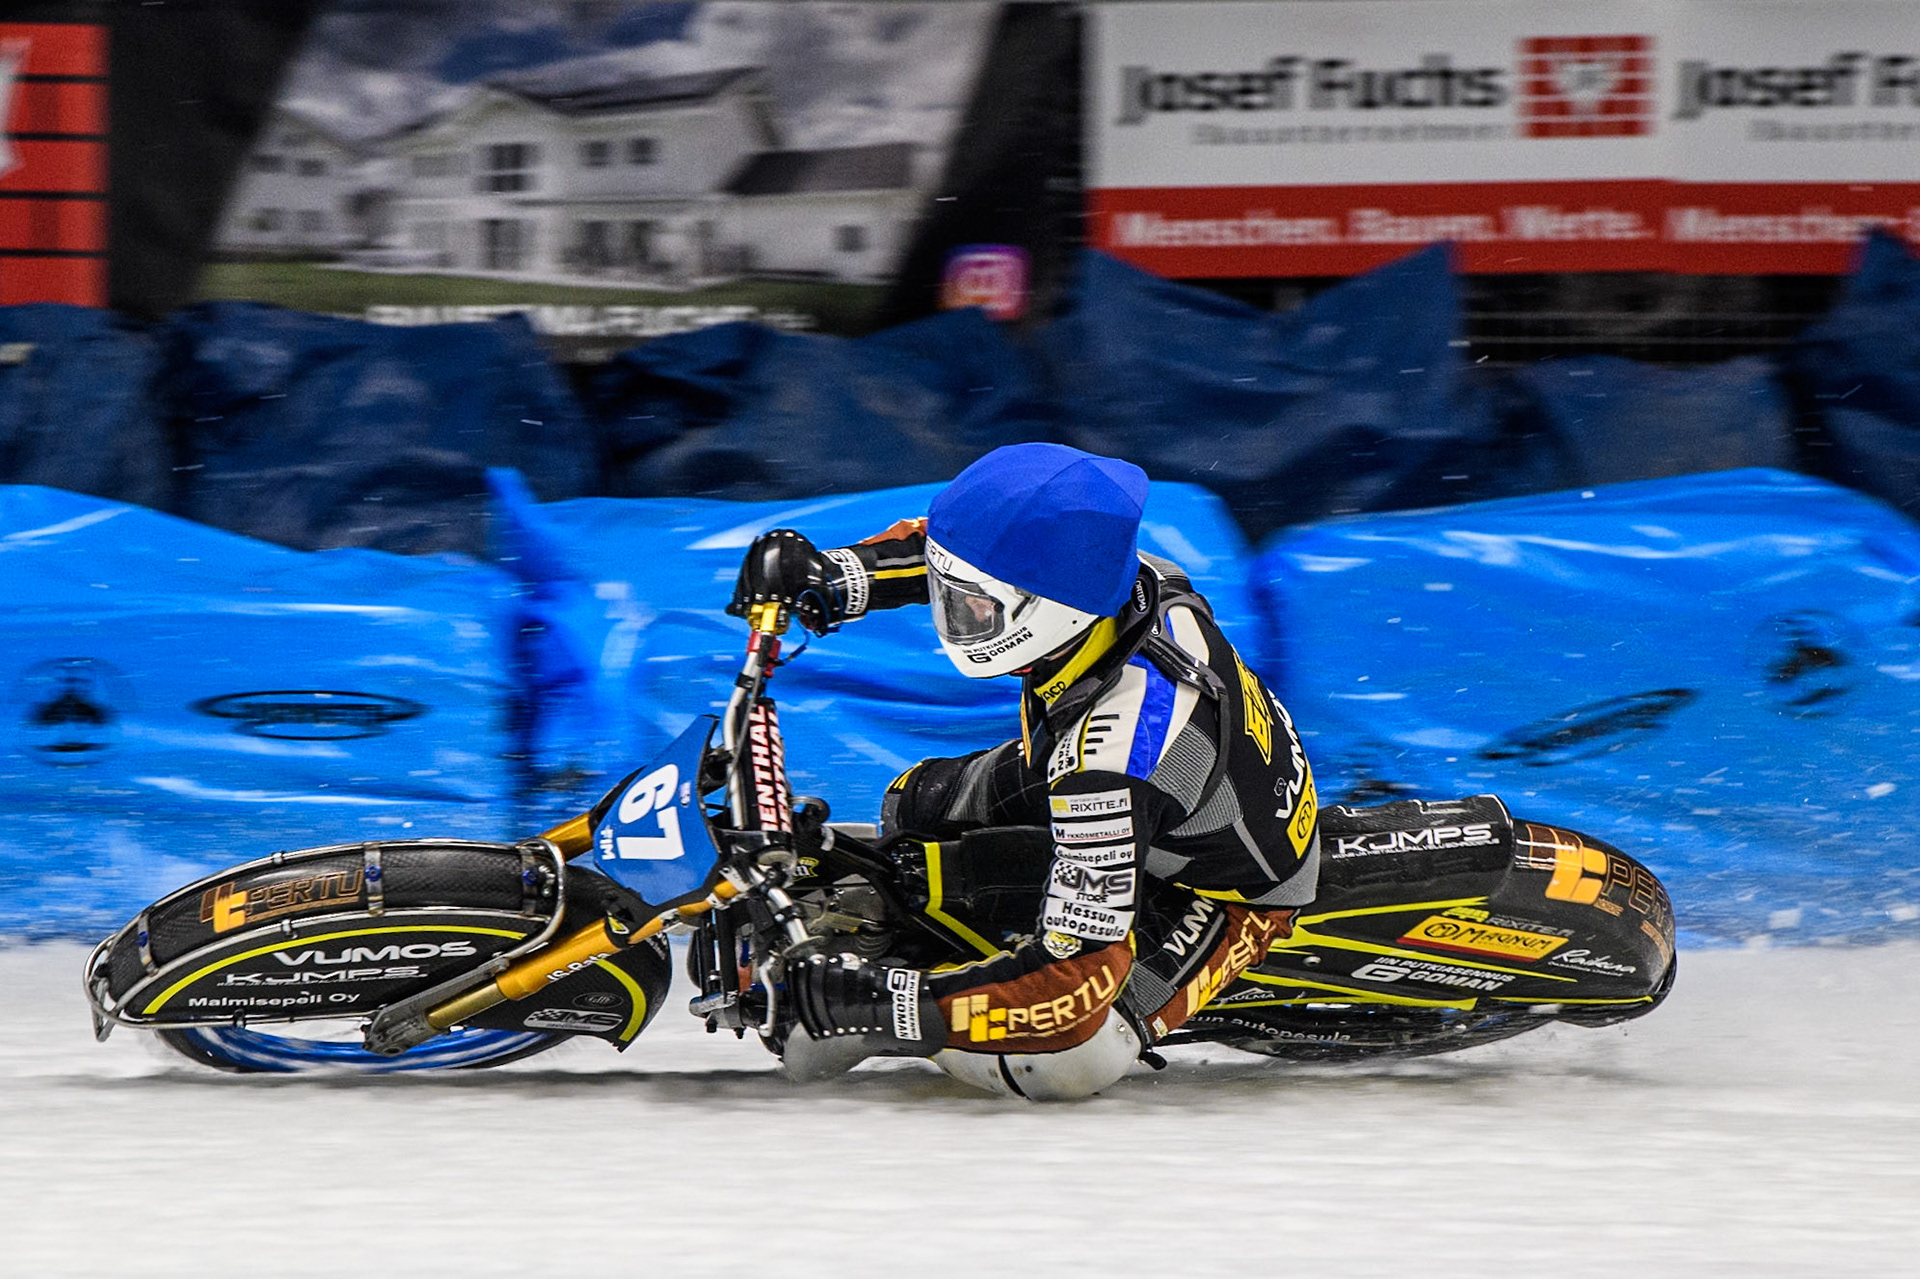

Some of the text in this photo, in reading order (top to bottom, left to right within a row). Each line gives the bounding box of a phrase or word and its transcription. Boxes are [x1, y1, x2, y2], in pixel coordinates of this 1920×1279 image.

[1116, 54, 1508, 126] Josef Fuchs
[1672, 53, 1866, 120] Josef
[990, 632, 1034, 657] GOMAN
[617, 763, 685, 861] 67
[1338, 823, 1493, 854] KJMPS
[247, 868, 364, 909] PERTU
[1062, 902, 1116, 924] Hessun
[1046, 916, 1125, 937] autopesula
[273, 940, 477, 966] VUMOS
[226, 966, 421, 984] KJMPS
[1399, 961, 1517, 982] PUTKIASENNUS
[1408, 971, 1504, 992] GOMAN
[328, 993, 361, 1004] Oy
[1009, 965, 1116, 1032] PERTU
[895, 993, 908, 1038] GOMAN
